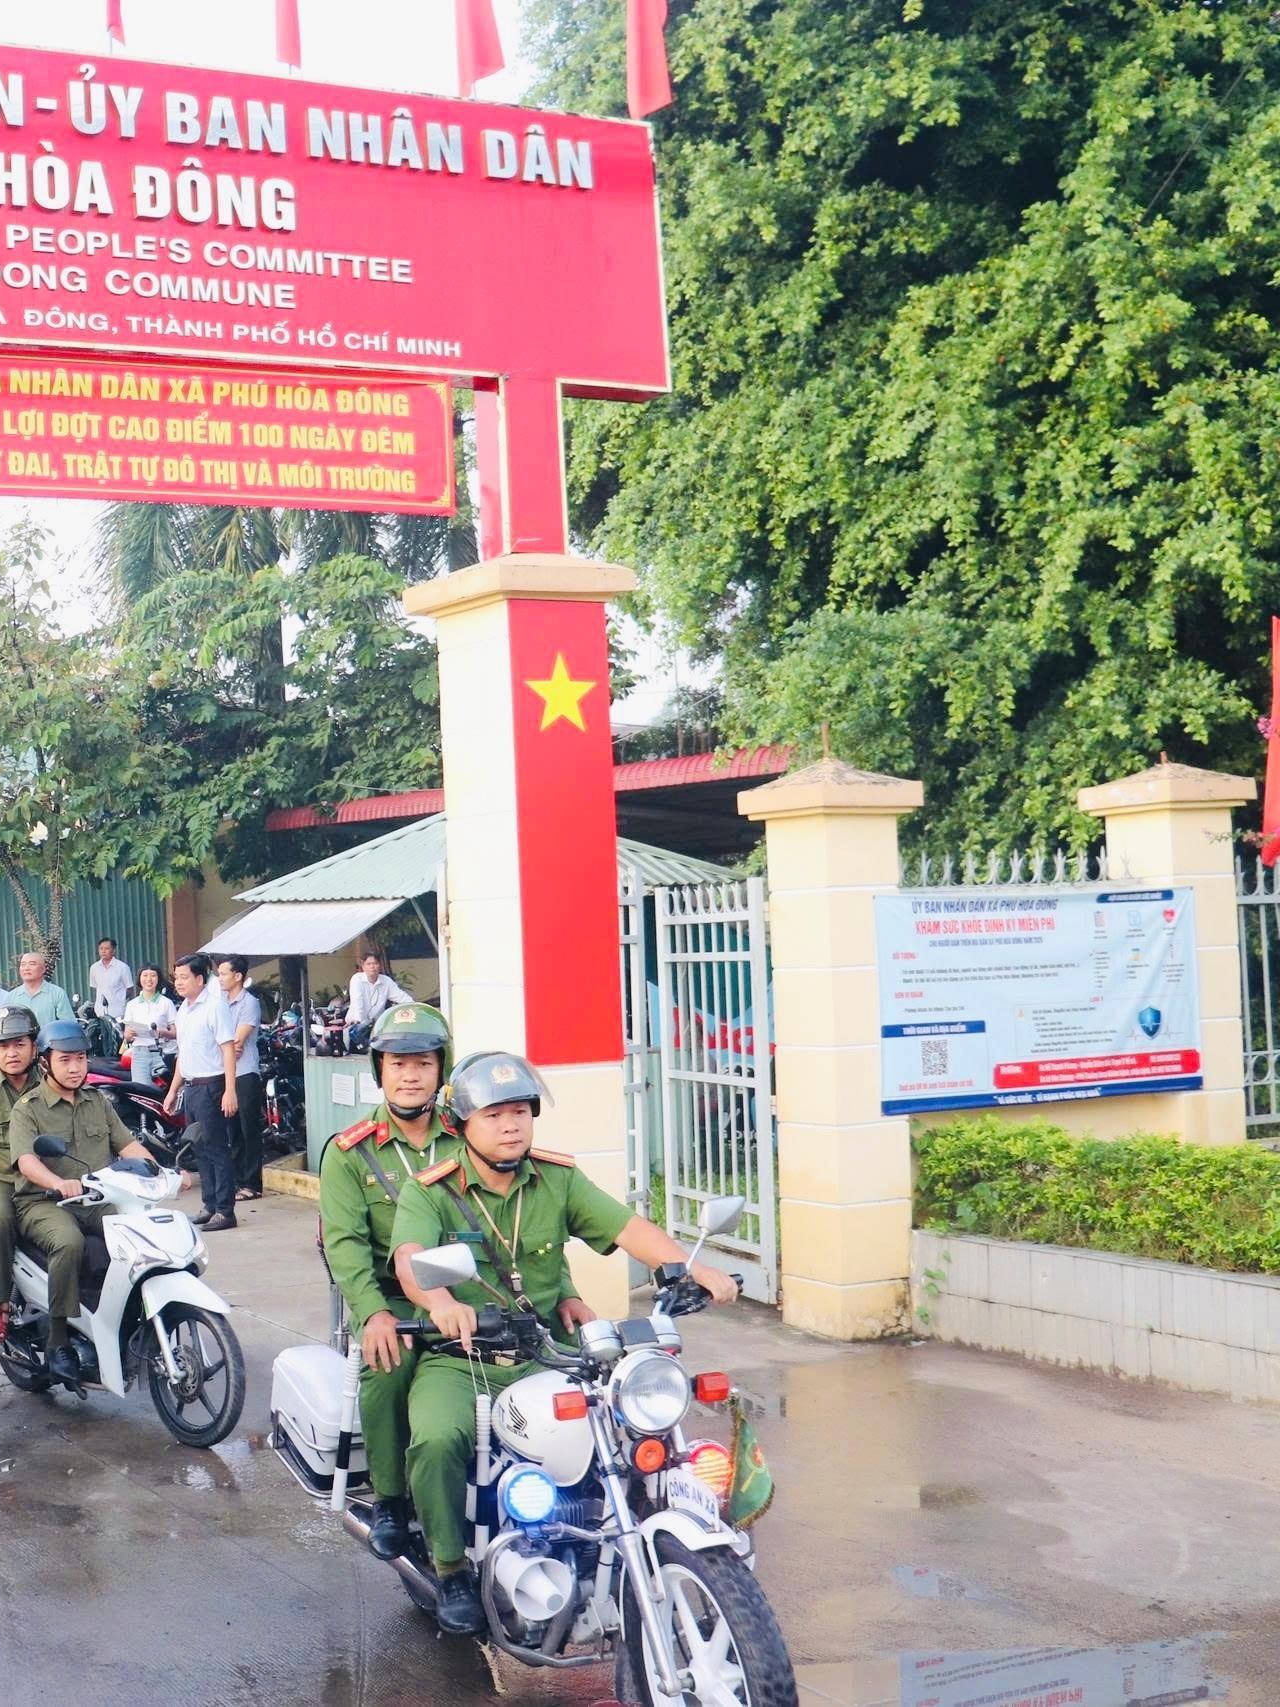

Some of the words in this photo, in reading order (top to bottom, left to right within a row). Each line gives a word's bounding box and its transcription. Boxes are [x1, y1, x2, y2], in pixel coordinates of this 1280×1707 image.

[165, 92, 286, 153] BAN
[308, 107, 463, 173] NHÂN
[481, 124, 593, 188] DÂN
[133, 157, 296, 230] ĐÔNG
[6, 224, 192, 262] PEOPLE'S
[204, 241, 413, 282] COMMITTEE
[105, 269, 296, 308] COMMUNE
[24, 306, 118, 334] ĐÔNG,
[126, 314, 222, 338] THÀNH
[233, 321, 290, 344] PHỐ
[298, 323, 336, 347] HỒ
[344, 332, 388, 351] CHÍ
[397, 337, 461, 357] MINH
[10, 369, 93, 397] NHÂN
[100, 372, 160, 400] DÂN
[168, 377, 205, 404] XÃ
[213, 381, 269, 407] PHÚ
[276, 383, 331, 411] HÒA
[336, 387, 410, 416] ĐÔNG
[3, 410, 45, 439] LỢI
[51, 412, 101, 442] ĐỢT
[108, 416, 160, 441] CAO
[165, 412, 233, 444] ĐIỂM
[241, 423, 285, 448] 100
[289, 425, 356, 451] NGÀY
[361, 426, 416, 454] ĐÊM
[8, 451, 56, 477] ĐAI,
[64, 452, 123, 479] TRẬT
[129, 457, 160, 483] TỰ
[162, 454, 196, 482] ĐÔ
[201, 460, 238, 487] THỊ
[243, 460, 273, 485] VÀ
[278, 461, 324, 488] MÔI
[327, 465, 416, 493] TRƯỜNG
